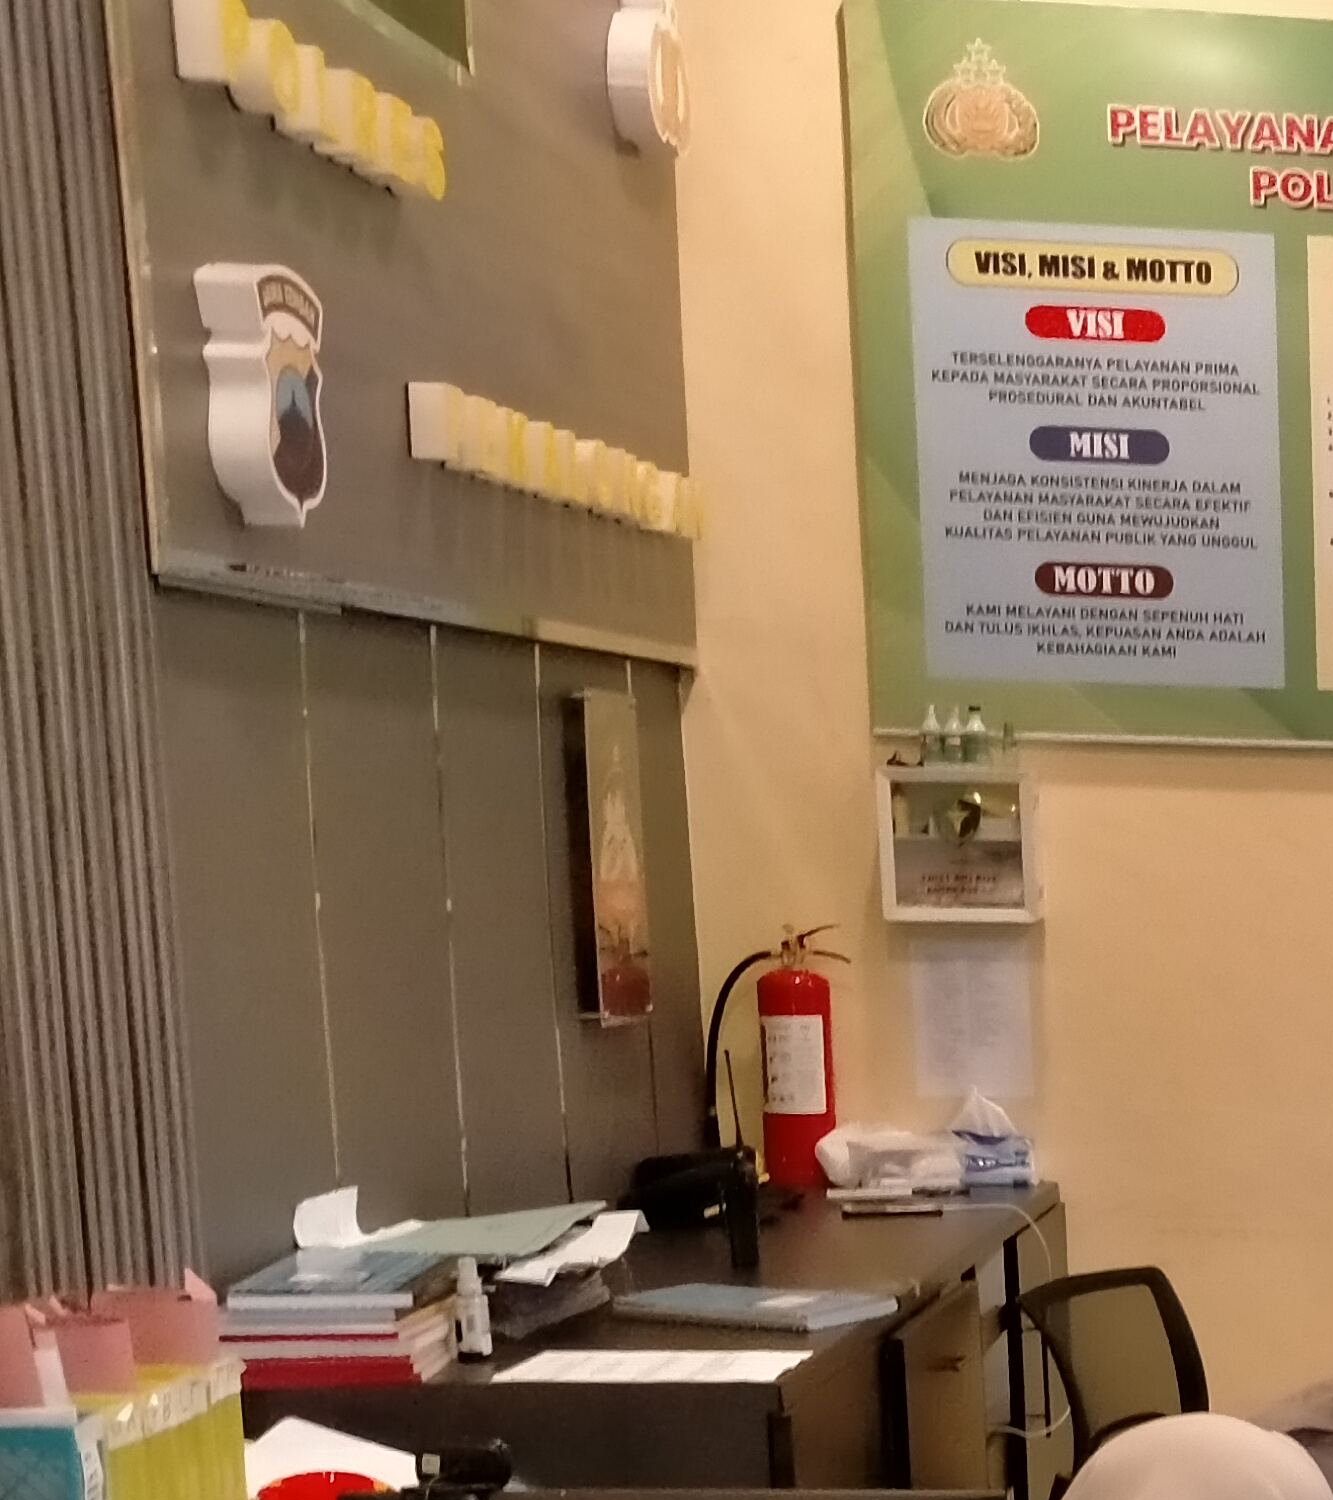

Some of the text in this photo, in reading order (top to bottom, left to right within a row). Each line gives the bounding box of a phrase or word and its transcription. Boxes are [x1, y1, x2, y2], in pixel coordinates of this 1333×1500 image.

[973, 250, 1212, 285] VISI, MISI & MOTTO
[1066, 309, 1125, 340] VISI
[1105, 358, 1190, 375] PELAYANAN
[1194, 362, 1240, 377] PRIMA
[930, 368, 989, 384] KEPADA
[992, 371, 1087, 388] MASYARAKAT
[1091, 375, 1148, 390] SECARA
[1087, 393, 1117, 407] DAN
[1120, 394, 1206, 410] AKUNTABEL
[1069, 431, 1130, 460] MISI
[958, 471, 1241, 495] MENJAGA KONSISTENSI KINERJA DALAM
[949, 489, 1033, 505] PELAYANAN
[1037, 492, 1131, 508] MASYARAKAT
[1134, 496, 1191, 511] SECARA
[983, 508, 1013, 522] DAN
[1075, 512, 1116, 526] GUNA
[1119, 513, 1220, 530] MEWUJUDKAN
[944, 525, 1013, 540] KUALITAS
[1016, 528, 1101, 543] PELAYANAN
[1105, 531, 1156, 545] PUBLIK
[1159, 533, 1197, 547] YANG
[1053, 566, 1155, 595] MOTTO
[965, 604, 1244, 624] KAMI MELAYANI DENGAN SEPENUH HATI
[944, 621, 974, 634] DAN
[978, 622, 1023, 635] TULUS
[1085, 625, 1161, 639] KEPUASAN
[1165, 628, 1204, 641] ANDA
[1208, 629, 1266, 643] ADALAH
[1141, 644, 1177, 656] KAMI
